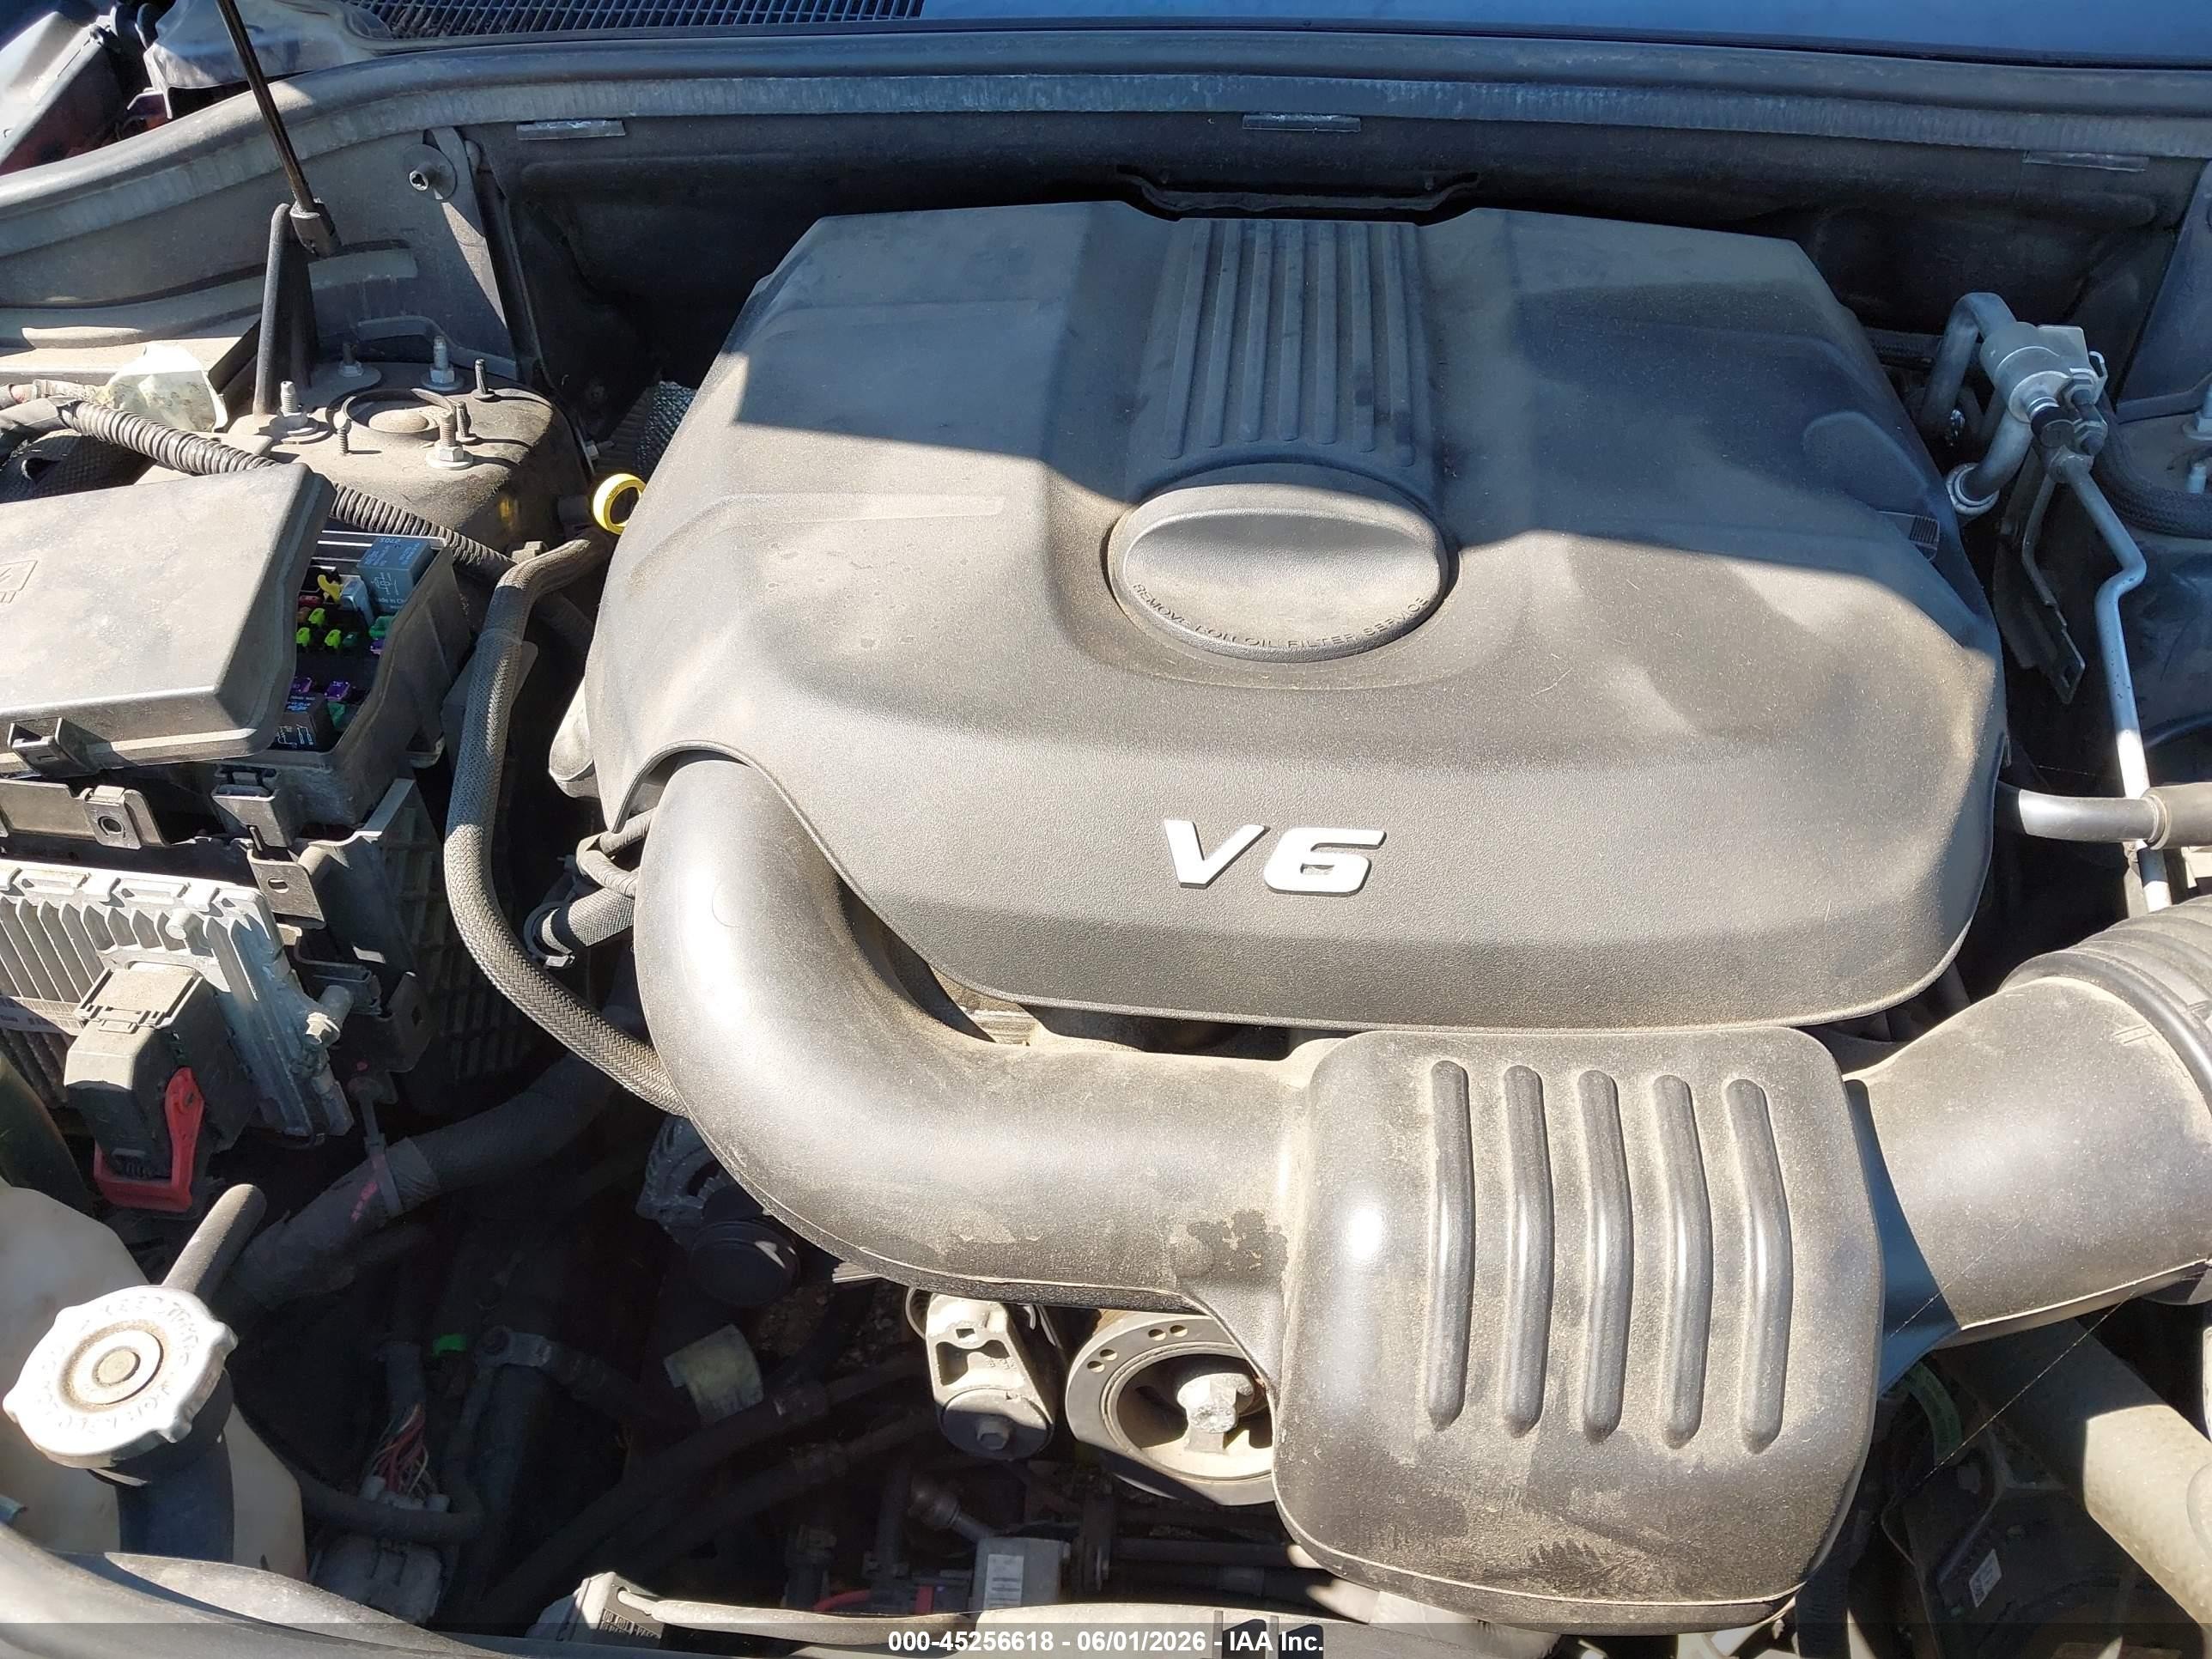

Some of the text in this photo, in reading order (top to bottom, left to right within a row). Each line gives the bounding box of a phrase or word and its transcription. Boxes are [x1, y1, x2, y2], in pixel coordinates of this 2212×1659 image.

[1244, 637, 1278, 648] OIL
[1287, 631, 1360, 649] FILTER
[1362, 597, 1429, 636] SERVICE
[1164, 818, 1387, 897] V6
